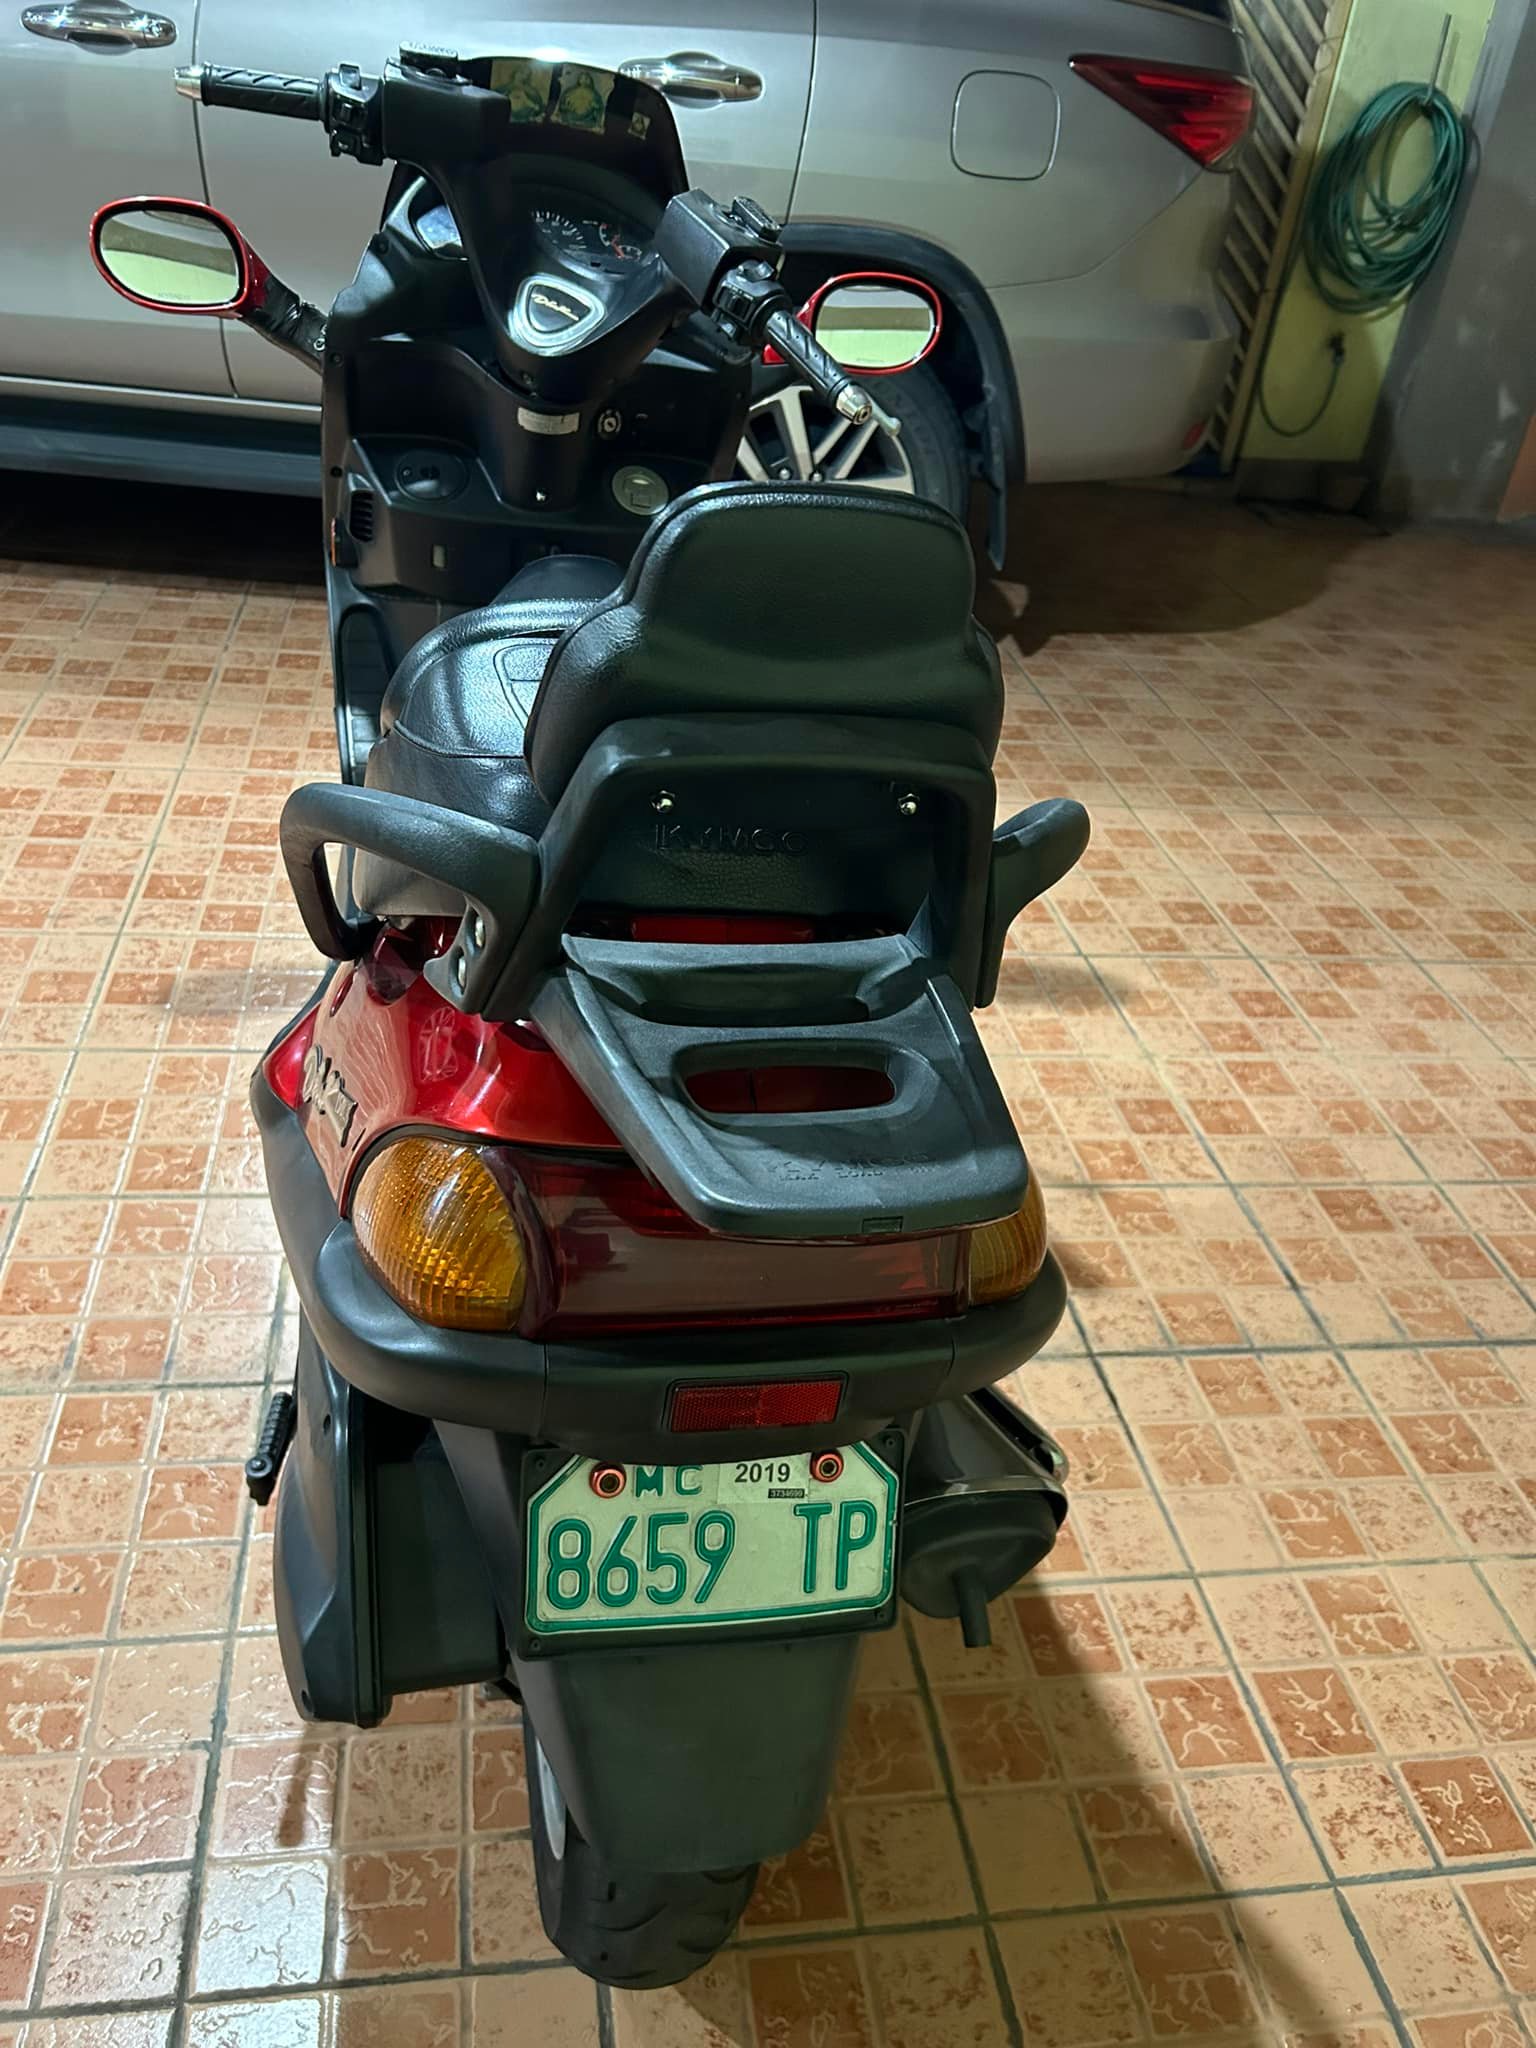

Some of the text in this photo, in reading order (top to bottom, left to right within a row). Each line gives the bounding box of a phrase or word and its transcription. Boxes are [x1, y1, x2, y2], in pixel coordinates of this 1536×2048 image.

[734, 1462, 791, 1483] 2019
[546, 1499, 878, 1611] 8659 TP
